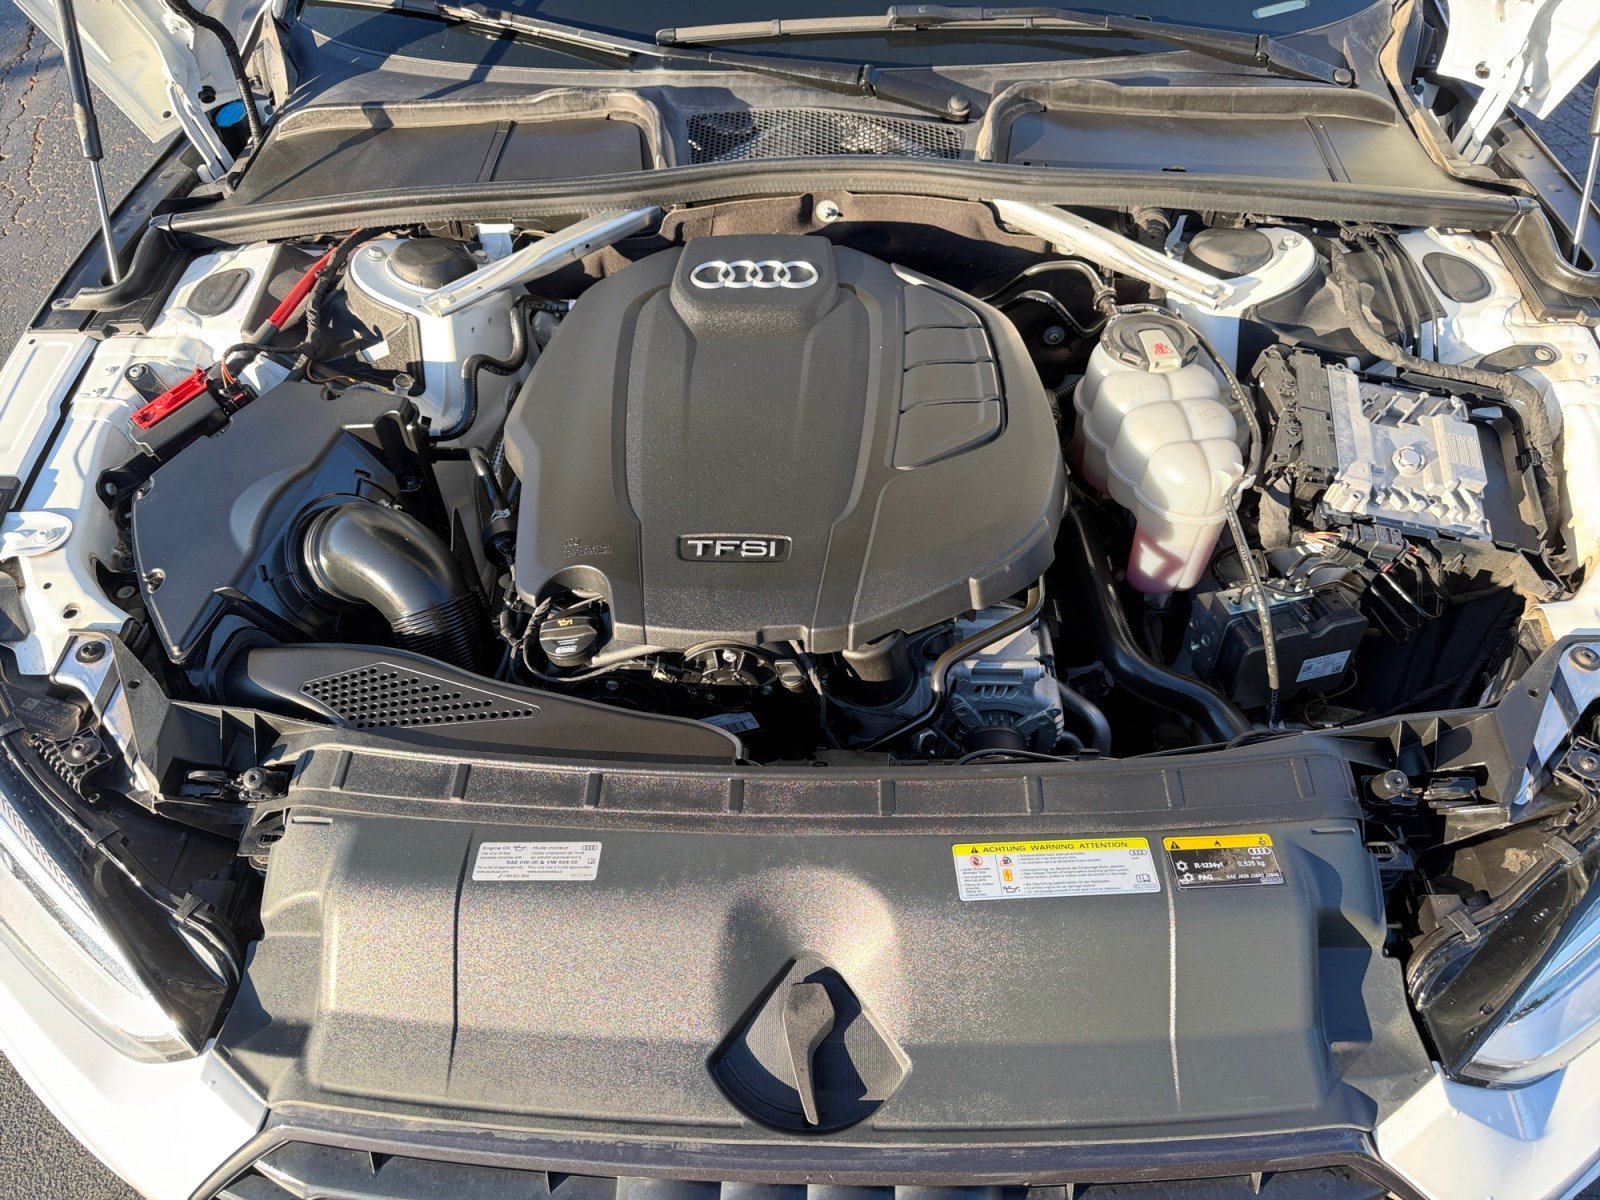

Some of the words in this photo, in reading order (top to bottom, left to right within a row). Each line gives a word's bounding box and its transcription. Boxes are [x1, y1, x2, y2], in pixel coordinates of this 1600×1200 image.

[687, 540, 776, 557] TFSI
[983, 845, 1026, 853] ACHTUNG
[1030, 843, 1075, 851] WARNING
[1079, 841, 1128, 849] ATTENTION
